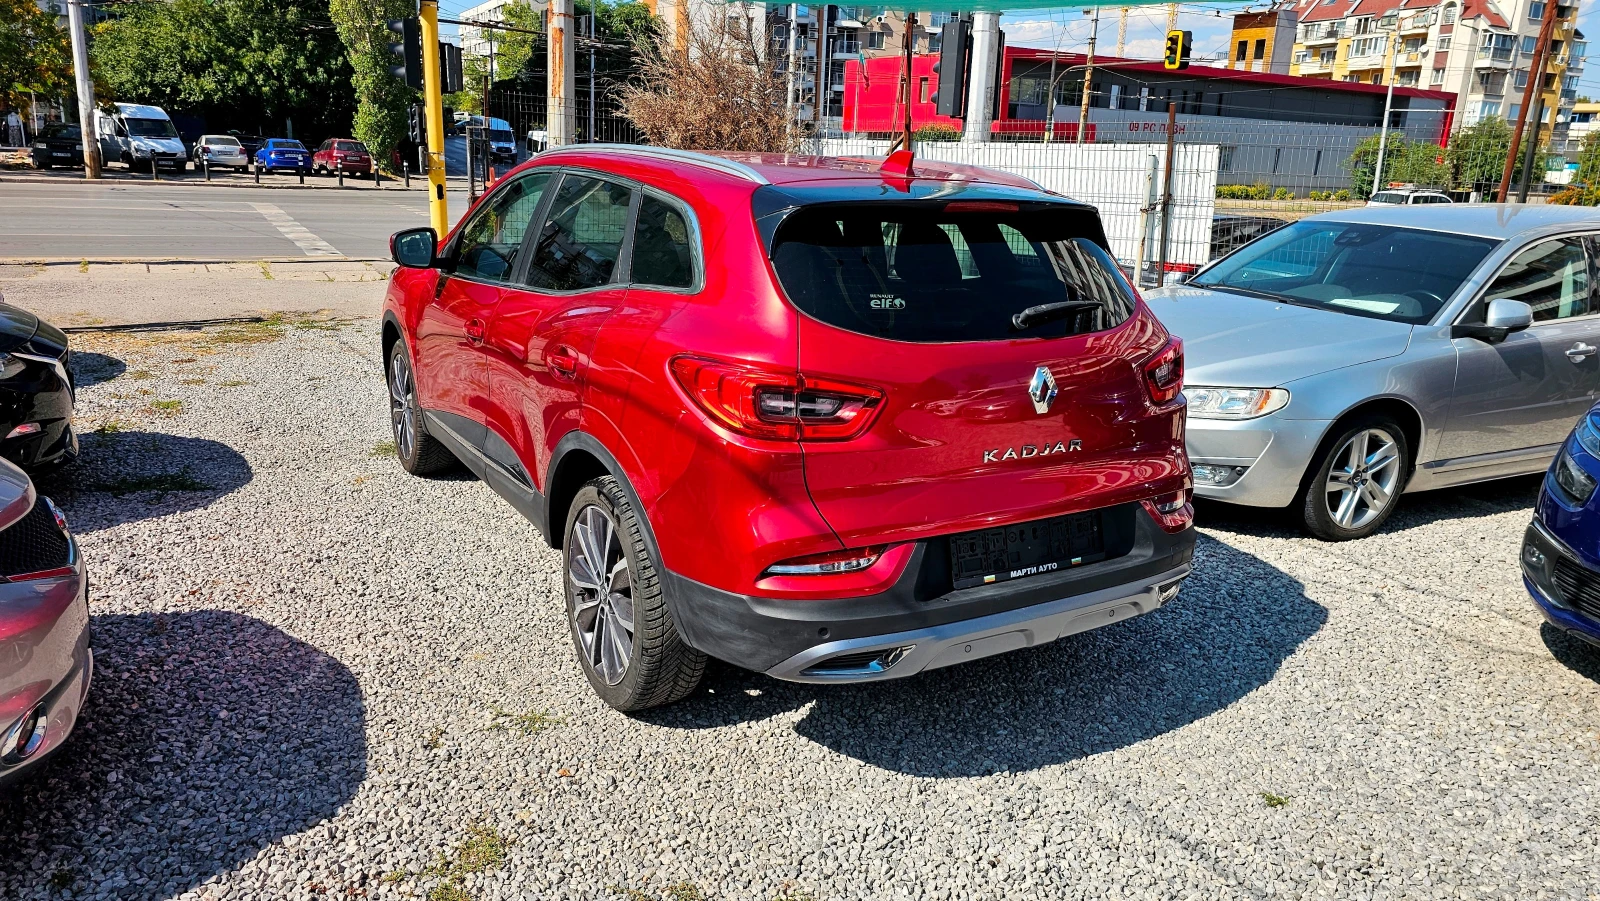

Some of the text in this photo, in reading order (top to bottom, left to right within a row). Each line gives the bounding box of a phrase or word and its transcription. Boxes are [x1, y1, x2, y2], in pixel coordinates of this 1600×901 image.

[1129, 122, 1140, 132] 09
[1159, 123, 1186, 135] ПЗН
[870, 298, 893, 308] elf
[983, 439, 1082, 463] KADJAR
[1010, 562, 1058, 578] МАРТИ АУТО
